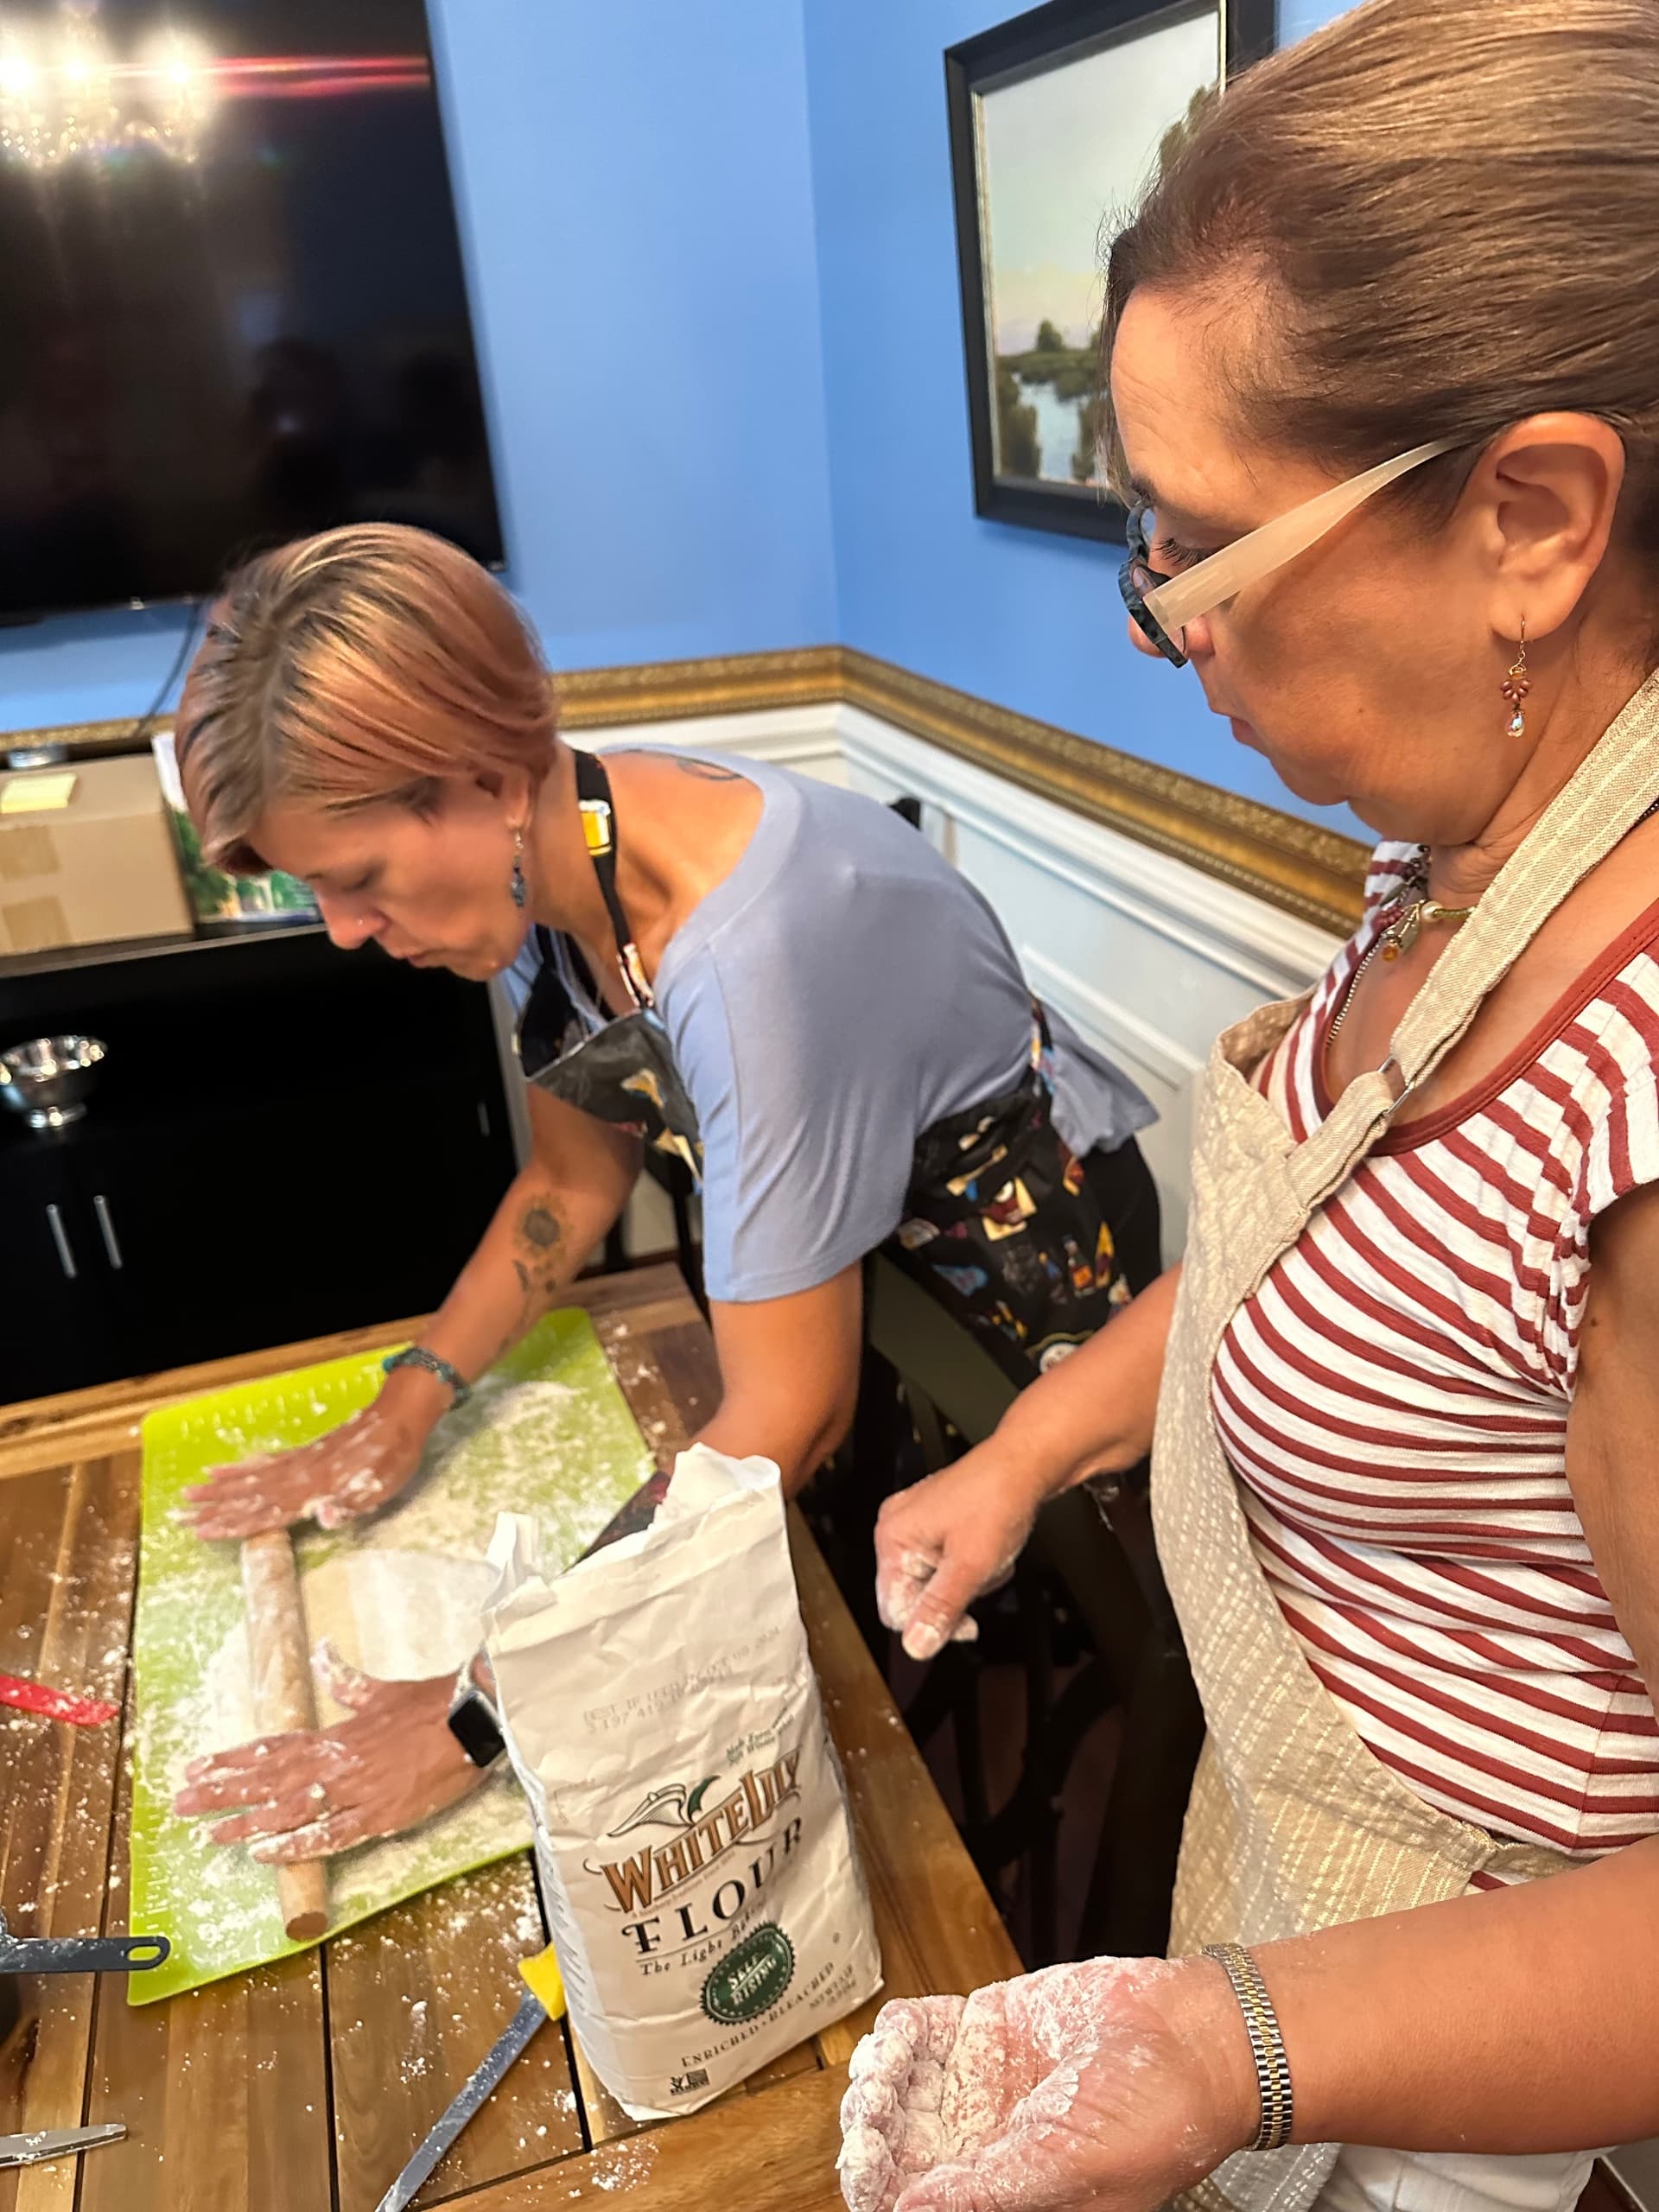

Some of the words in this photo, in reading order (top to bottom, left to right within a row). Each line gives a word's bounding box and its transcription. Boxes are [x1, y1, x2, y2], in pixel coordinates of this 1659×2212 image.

[621, 1816, 803, 1955] FLOUR
[639, 1960, 671, 1977] The
[680, 1939, 722, 1967] Light
[681, 2024, 760, 2068] ENRICHED
[768, 1961, 835, 2023] BLEACHED
